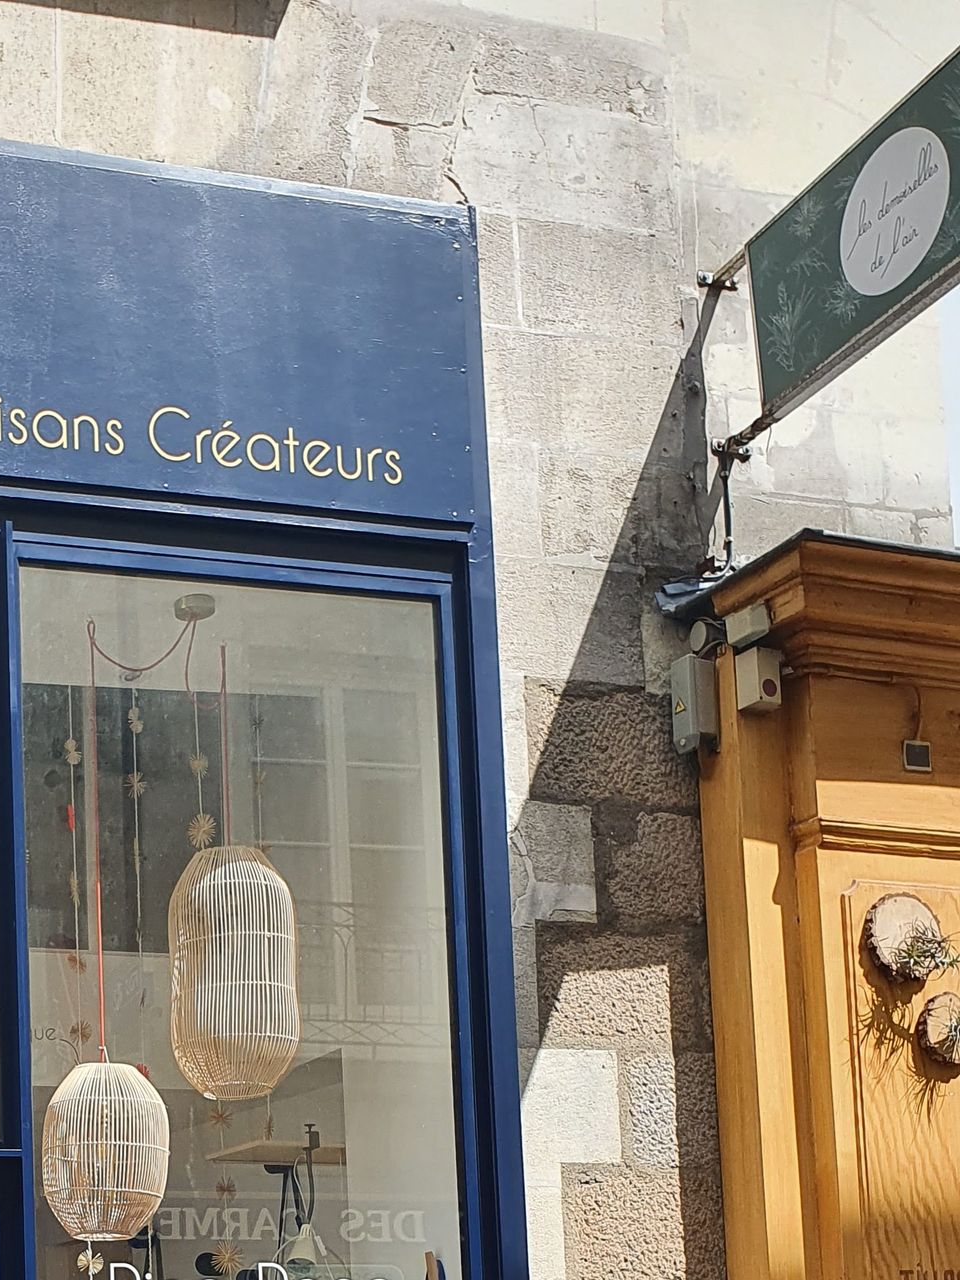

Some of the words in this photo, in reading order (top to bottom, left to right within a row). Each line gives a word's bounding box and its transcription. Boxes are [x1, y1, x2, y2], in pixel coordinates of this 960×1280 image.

[846, 199, 872, 260] les
[878, 142, 938, 220] demoiselles
[870, 233, 884, 272] de
[148, 406, 403, 486] Créateurs
